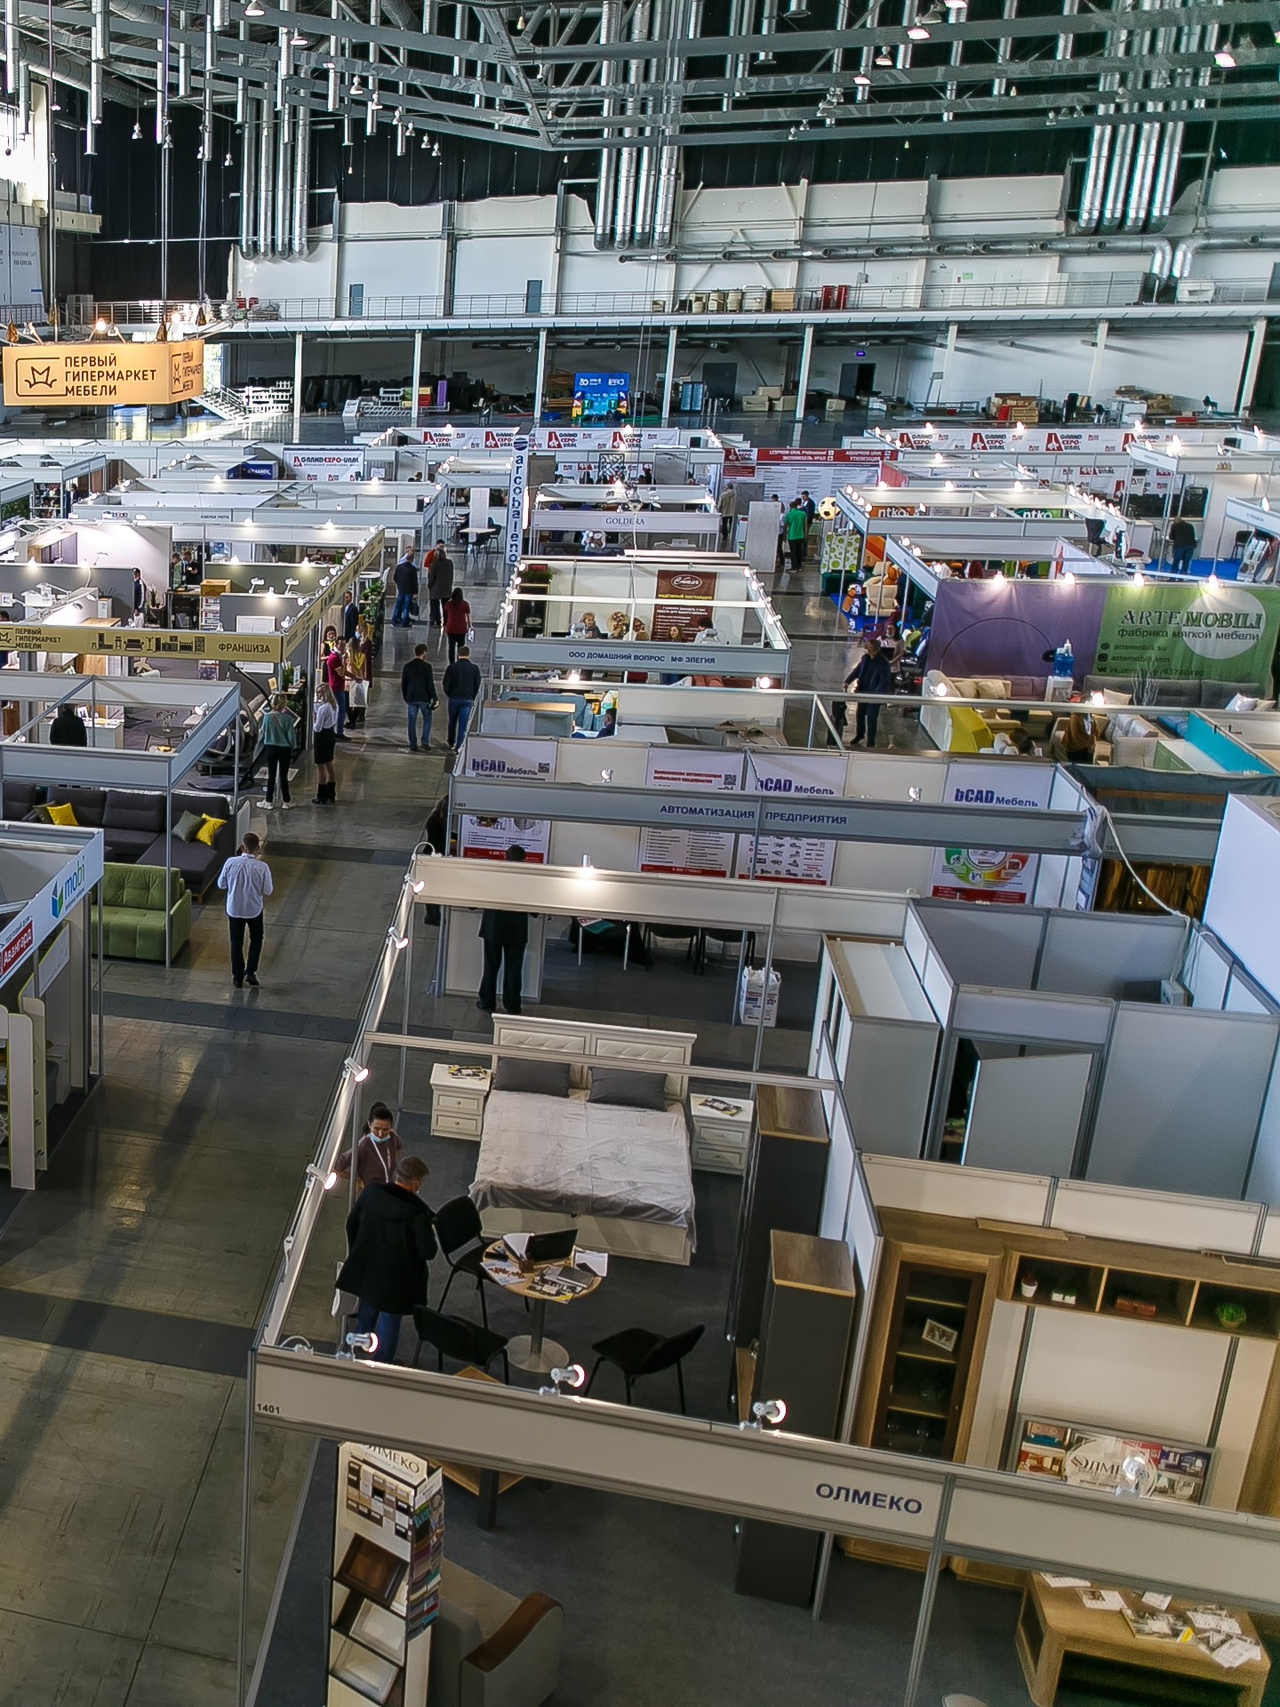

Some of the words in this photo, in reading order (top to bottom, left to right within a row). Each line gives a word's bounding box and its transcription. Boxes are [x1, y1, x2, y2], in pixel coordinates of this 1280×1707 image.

[64, 353, 117, 368] ПЕРВЫЙ
[65, 370, 156, 382] ГИПЕРМАРКЕТ
[65, 385, 117, 397] МЕБЕЛИ
[509, 455, 524, 563] arcobaleno
[15, 635, 61, 643] ГИПЕРМАРКЕТ
[1118, 628, 1167, 638] фабрика
[1172, 630, 1211, 639] мягкой
[1216, 631, 1259, 640] мебели
[218, 643, 270, 654] ФРАНШИЗА
[587, 652, 632, 661] ДОМАШНИЙ
[634, 654, 665, 662] ВОПРОС
[685, 656, 715, 664] ЭЛЕГИЯ
[472, 759, 506, 773] bCAD
[795, 786, 834, 795] Мебель
[955, 788, 995, 804] bCAD
[995, 796, 1038, 807] Мебель
[660, 805, 755, 819] АВТОМАТИЗАЦИЯ
[765, 812, 847, 825] ПРЕДПРИЯТИЯ
[65, 855, 84, 900] mobi
[257, 1403, 280, 1414] 1401
[815, 1482, 923, 1515] ОЛМЕКО
